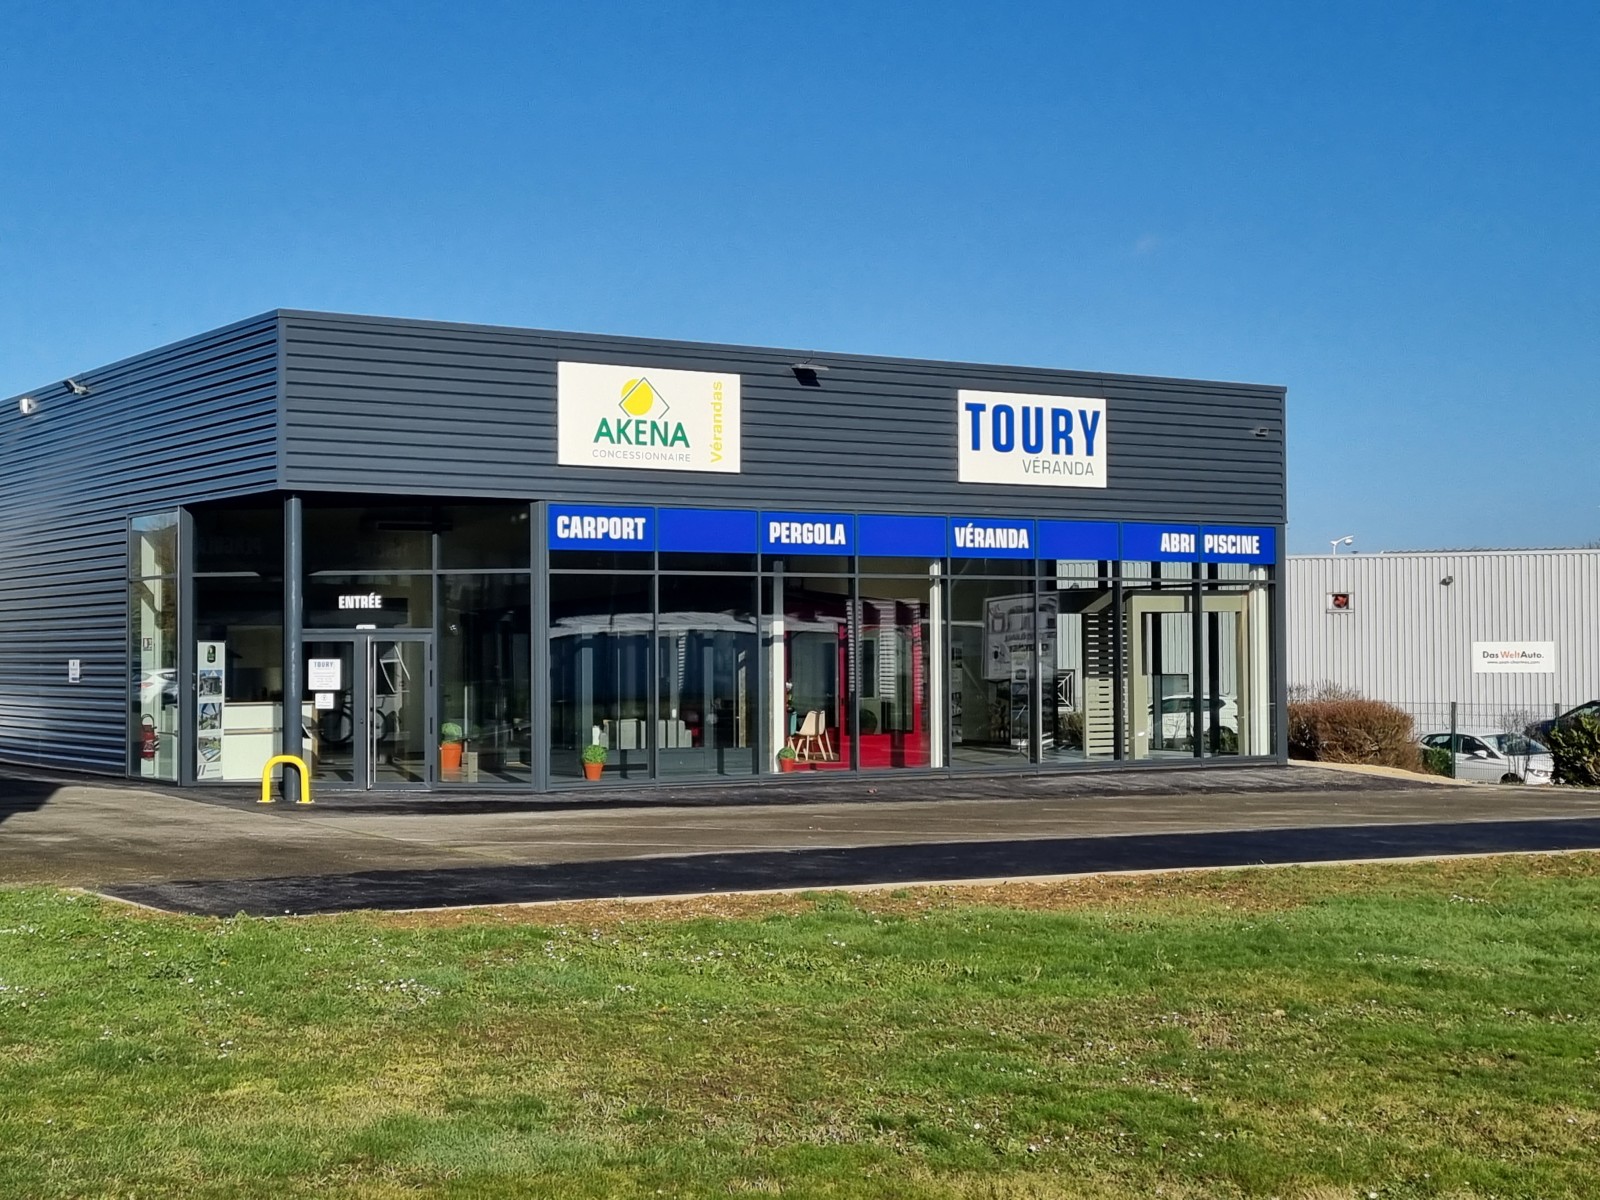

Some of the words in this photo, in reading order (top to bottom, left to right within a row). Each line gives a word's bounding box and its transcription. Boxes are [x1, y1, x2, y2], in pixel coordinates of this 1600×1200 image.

[593, 417, 690, 448] AKENA
[710, 381, 723, 463] Vérandas
[965, 402, 1101, 457] TOURY
[592, 449, 691, 463] CONCESSIONNAIRE
[1022, 456, 1095, 476] VÉRANDA
[556, 515, 646, 540] CARPORT
[769, 522, 846, 545] PERGOLA
[954, 523, 1030, 549] VÉRANDA
[1160, 533, 1195, 553] ABRI
[1204, 534, 1260, 555] PISCINE
[338, 592, 382, 610] ENTRÉE
[1482, 650, 1499, 659] Das
